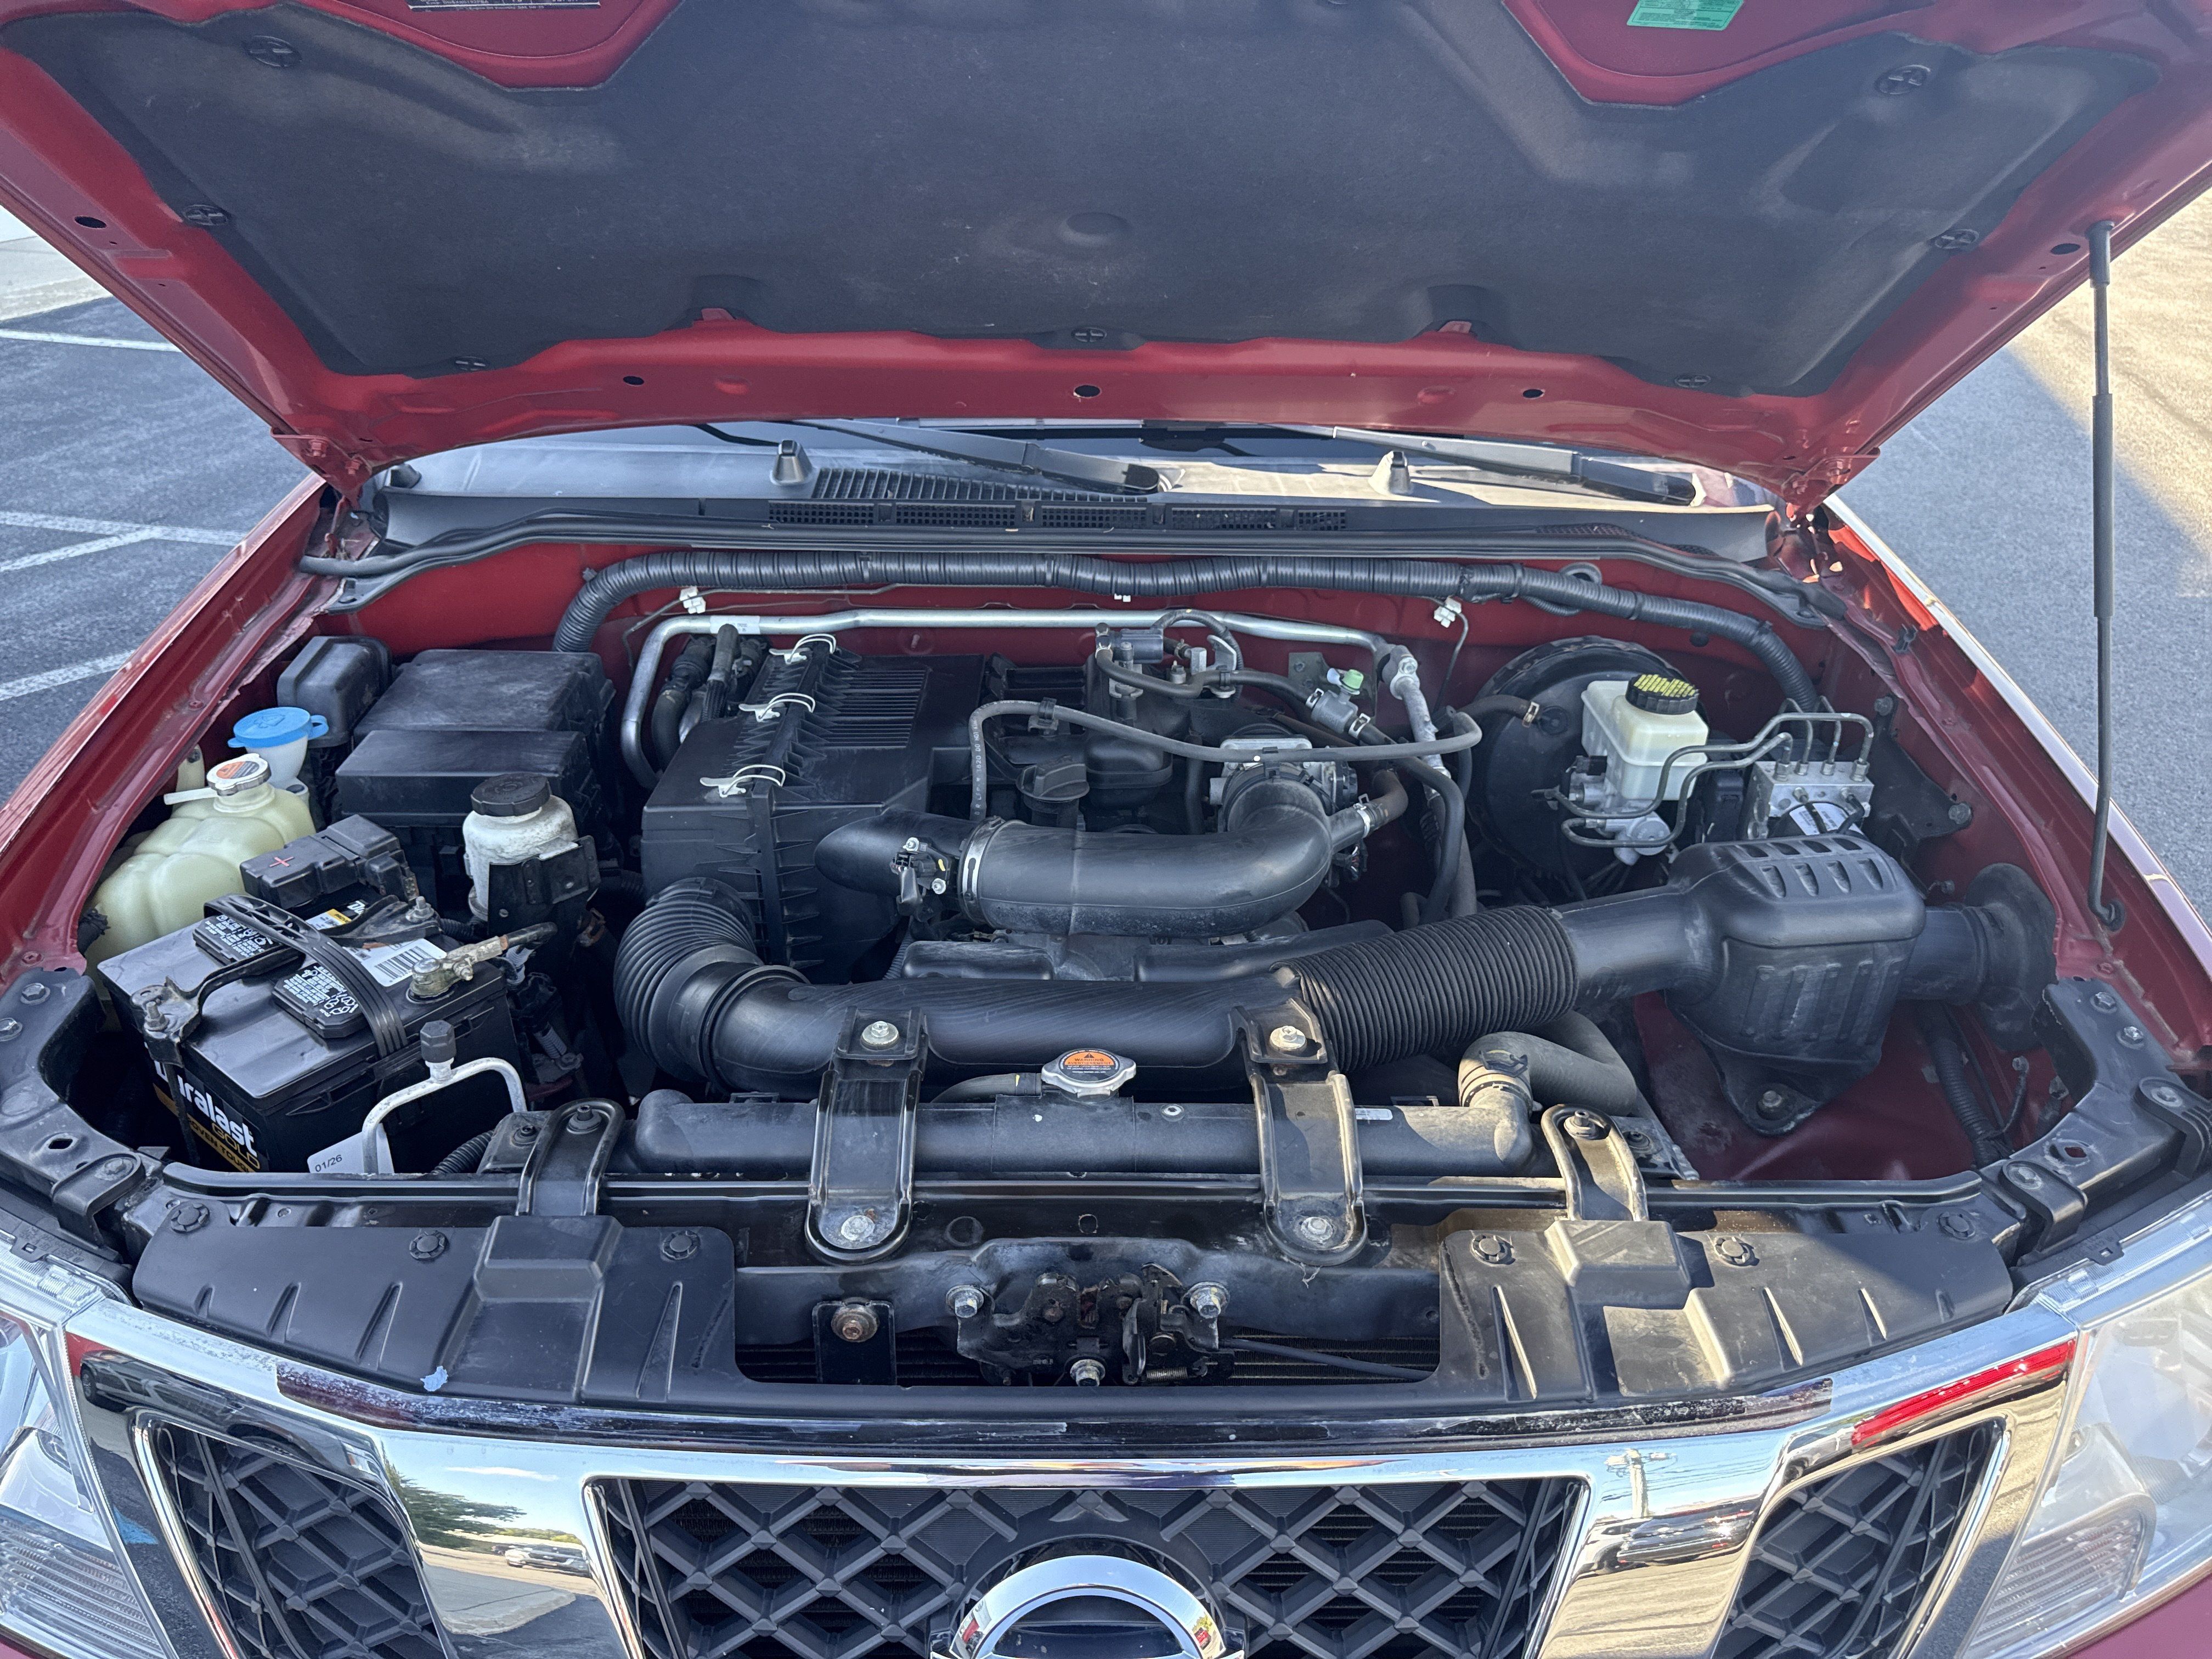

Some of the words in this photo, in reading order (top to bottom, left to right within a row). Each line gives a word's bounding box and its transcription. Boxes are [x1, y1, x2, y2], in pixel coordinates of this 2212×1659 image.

[974, 743, 981, 752] DO
[190, 1120, 218, 1147] OVEN
[211, 1122, 261, 1169] GOLD
[314, 1154, 343, 1172] 01/26
